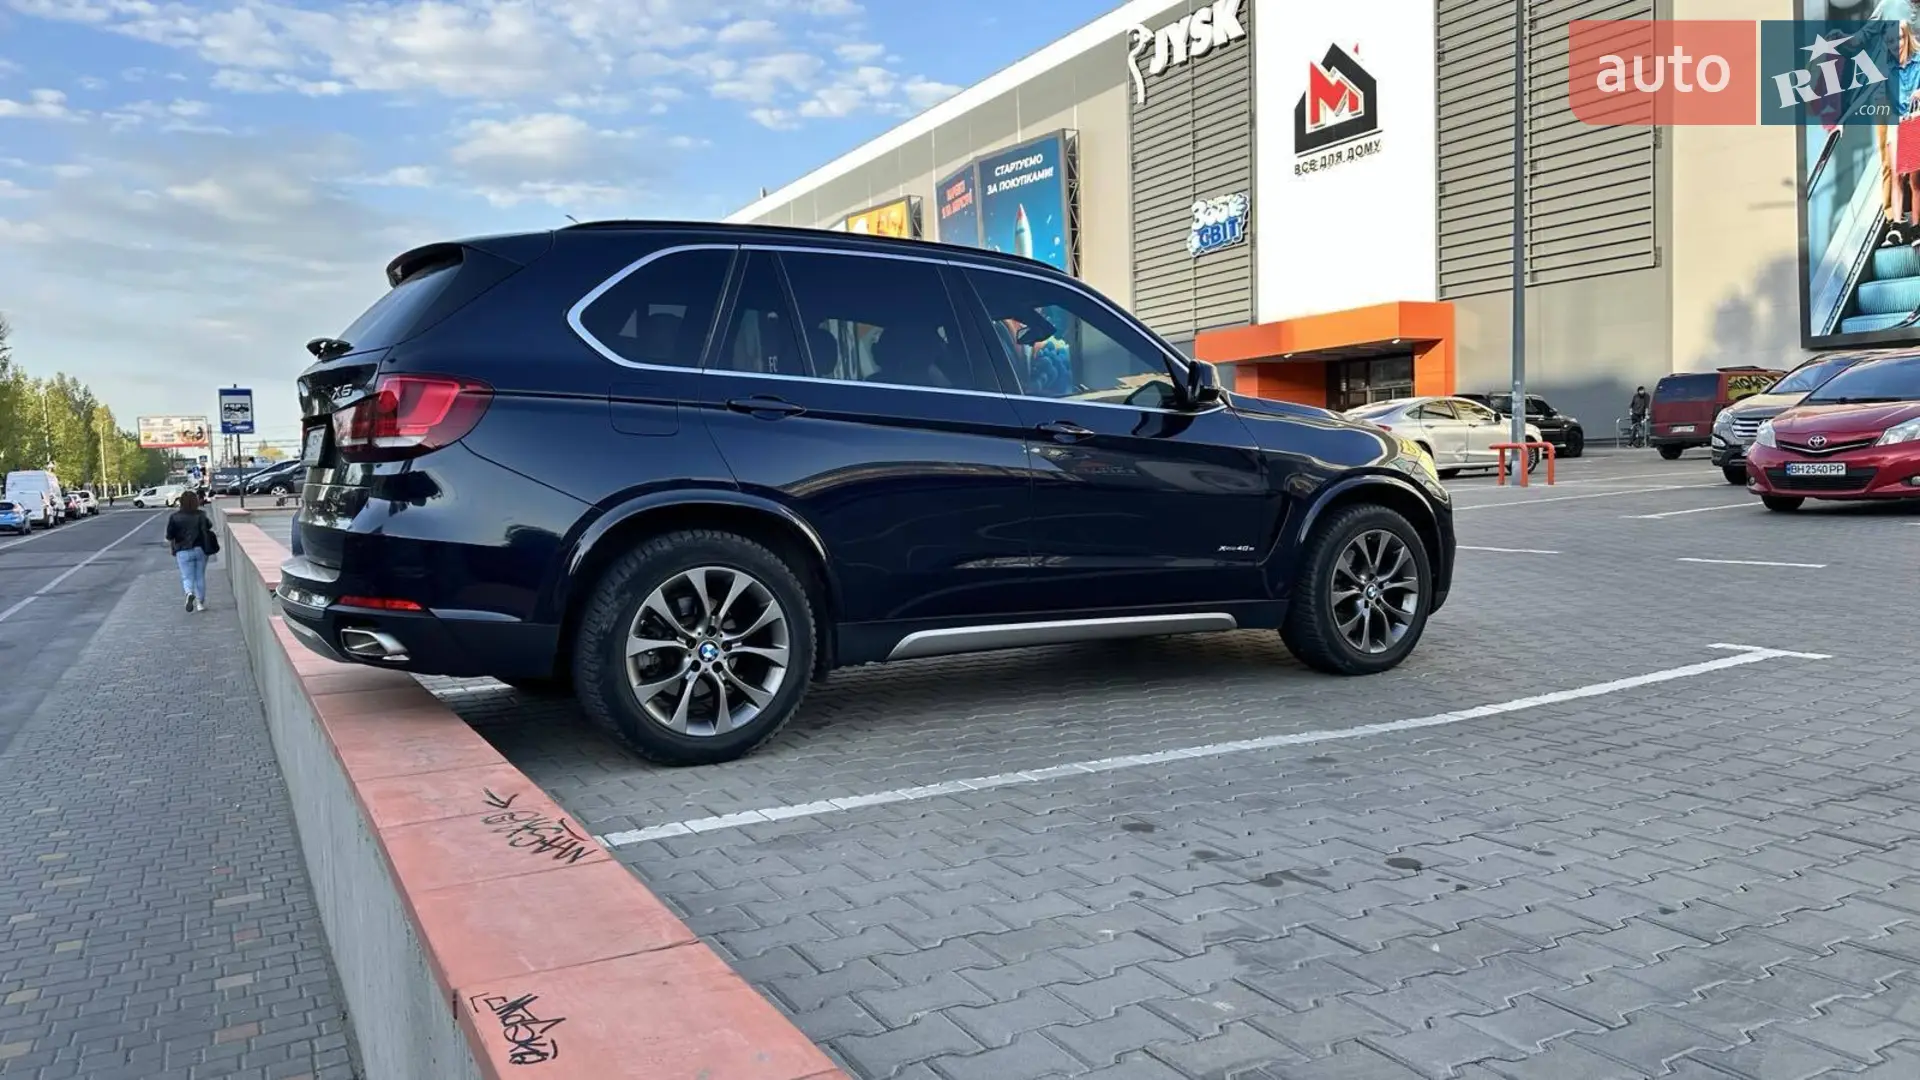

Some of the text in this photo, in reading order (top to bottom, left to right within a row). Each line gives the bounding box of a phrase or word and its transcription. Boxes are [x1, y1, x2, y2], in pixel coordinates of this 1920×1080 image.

[1149, 0, 1247, 77] JYSK
[1294, 139, 1382, 176] ВСЕ ДЛЯ ДОМУ
[986, 183, 998, 195] ЗА
[999, 166, 1054, 191] ПОКУПКАМИ!
[1829, 464, 1844, 474] PP
